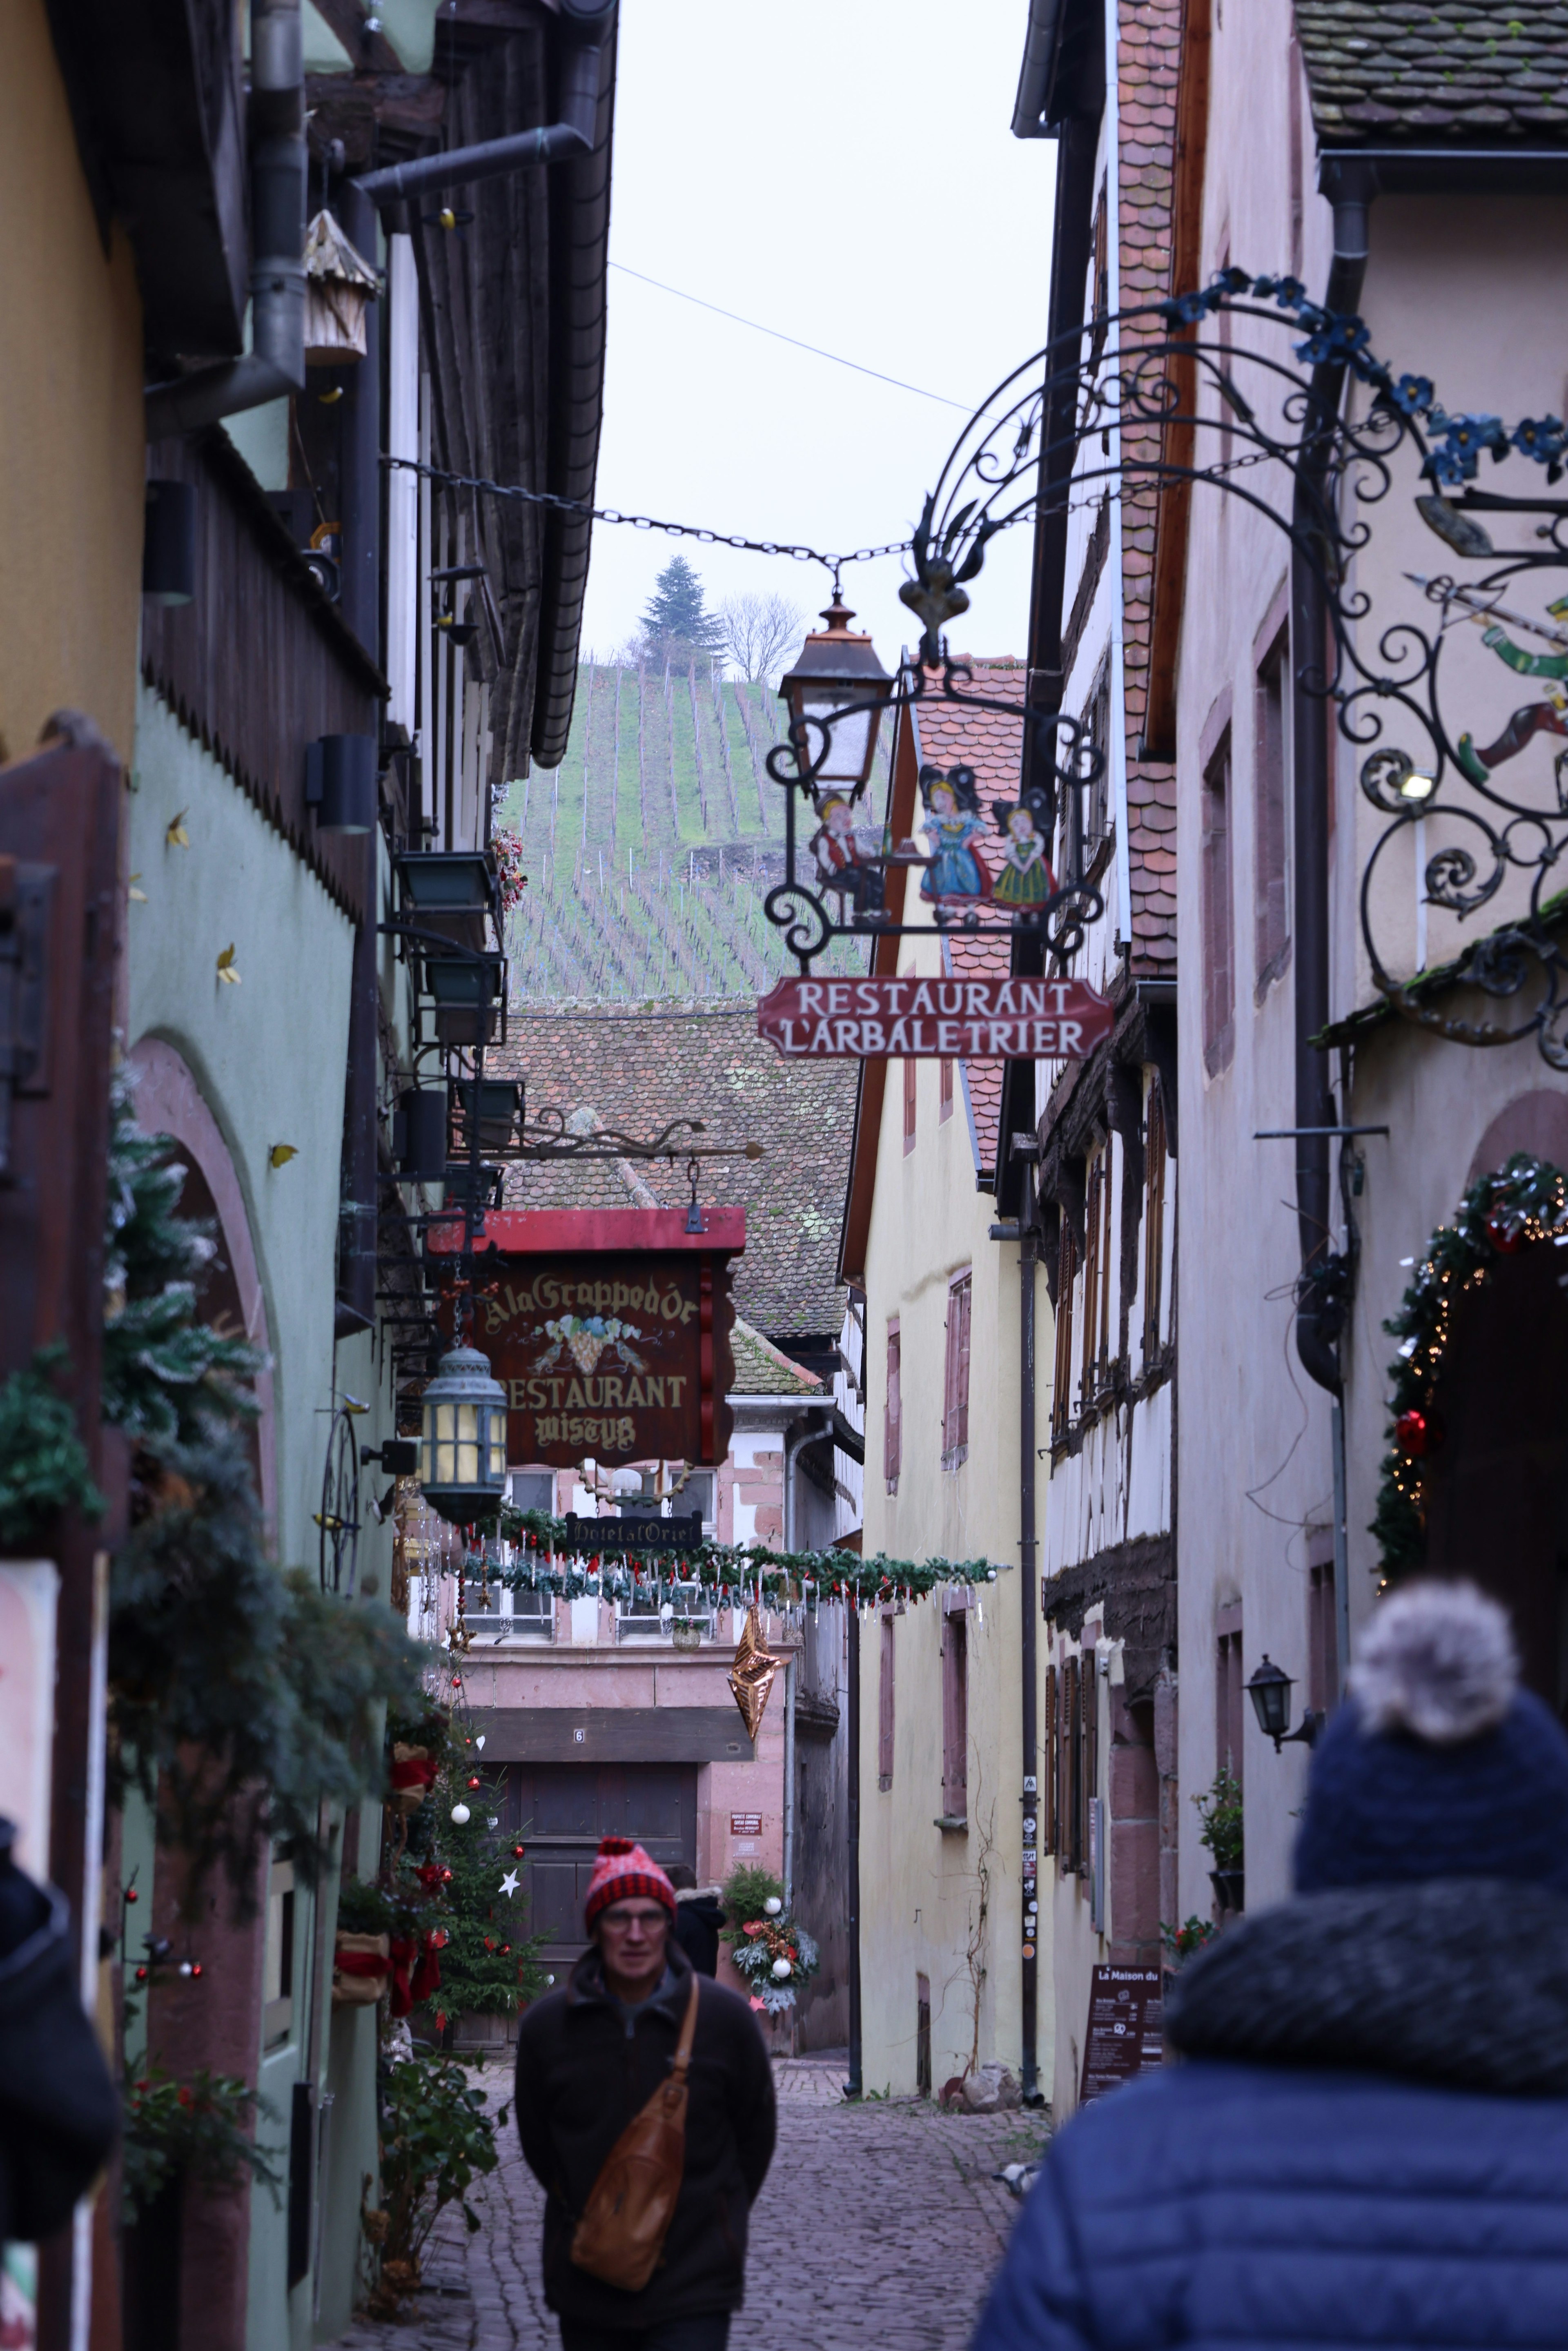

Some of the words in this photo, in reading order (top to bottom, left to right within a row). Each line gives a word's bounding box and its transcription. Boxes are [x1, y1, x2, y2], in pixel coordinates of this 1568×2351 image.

[796, 981, 1071, 1017] RESTAURANT
[779, 1017, 1082, 1054] L'ARBALETRIER
[505, 1284, 535, 1315] la
[533, 1273, 644, 1314] Grappe
[576, 1731, 582, 1741] 6
[1098, 1970, 1109, 1980] La
[1111, 1970, 1144, 1980] Maison
[1145, 1971, 1158, 1981] du
